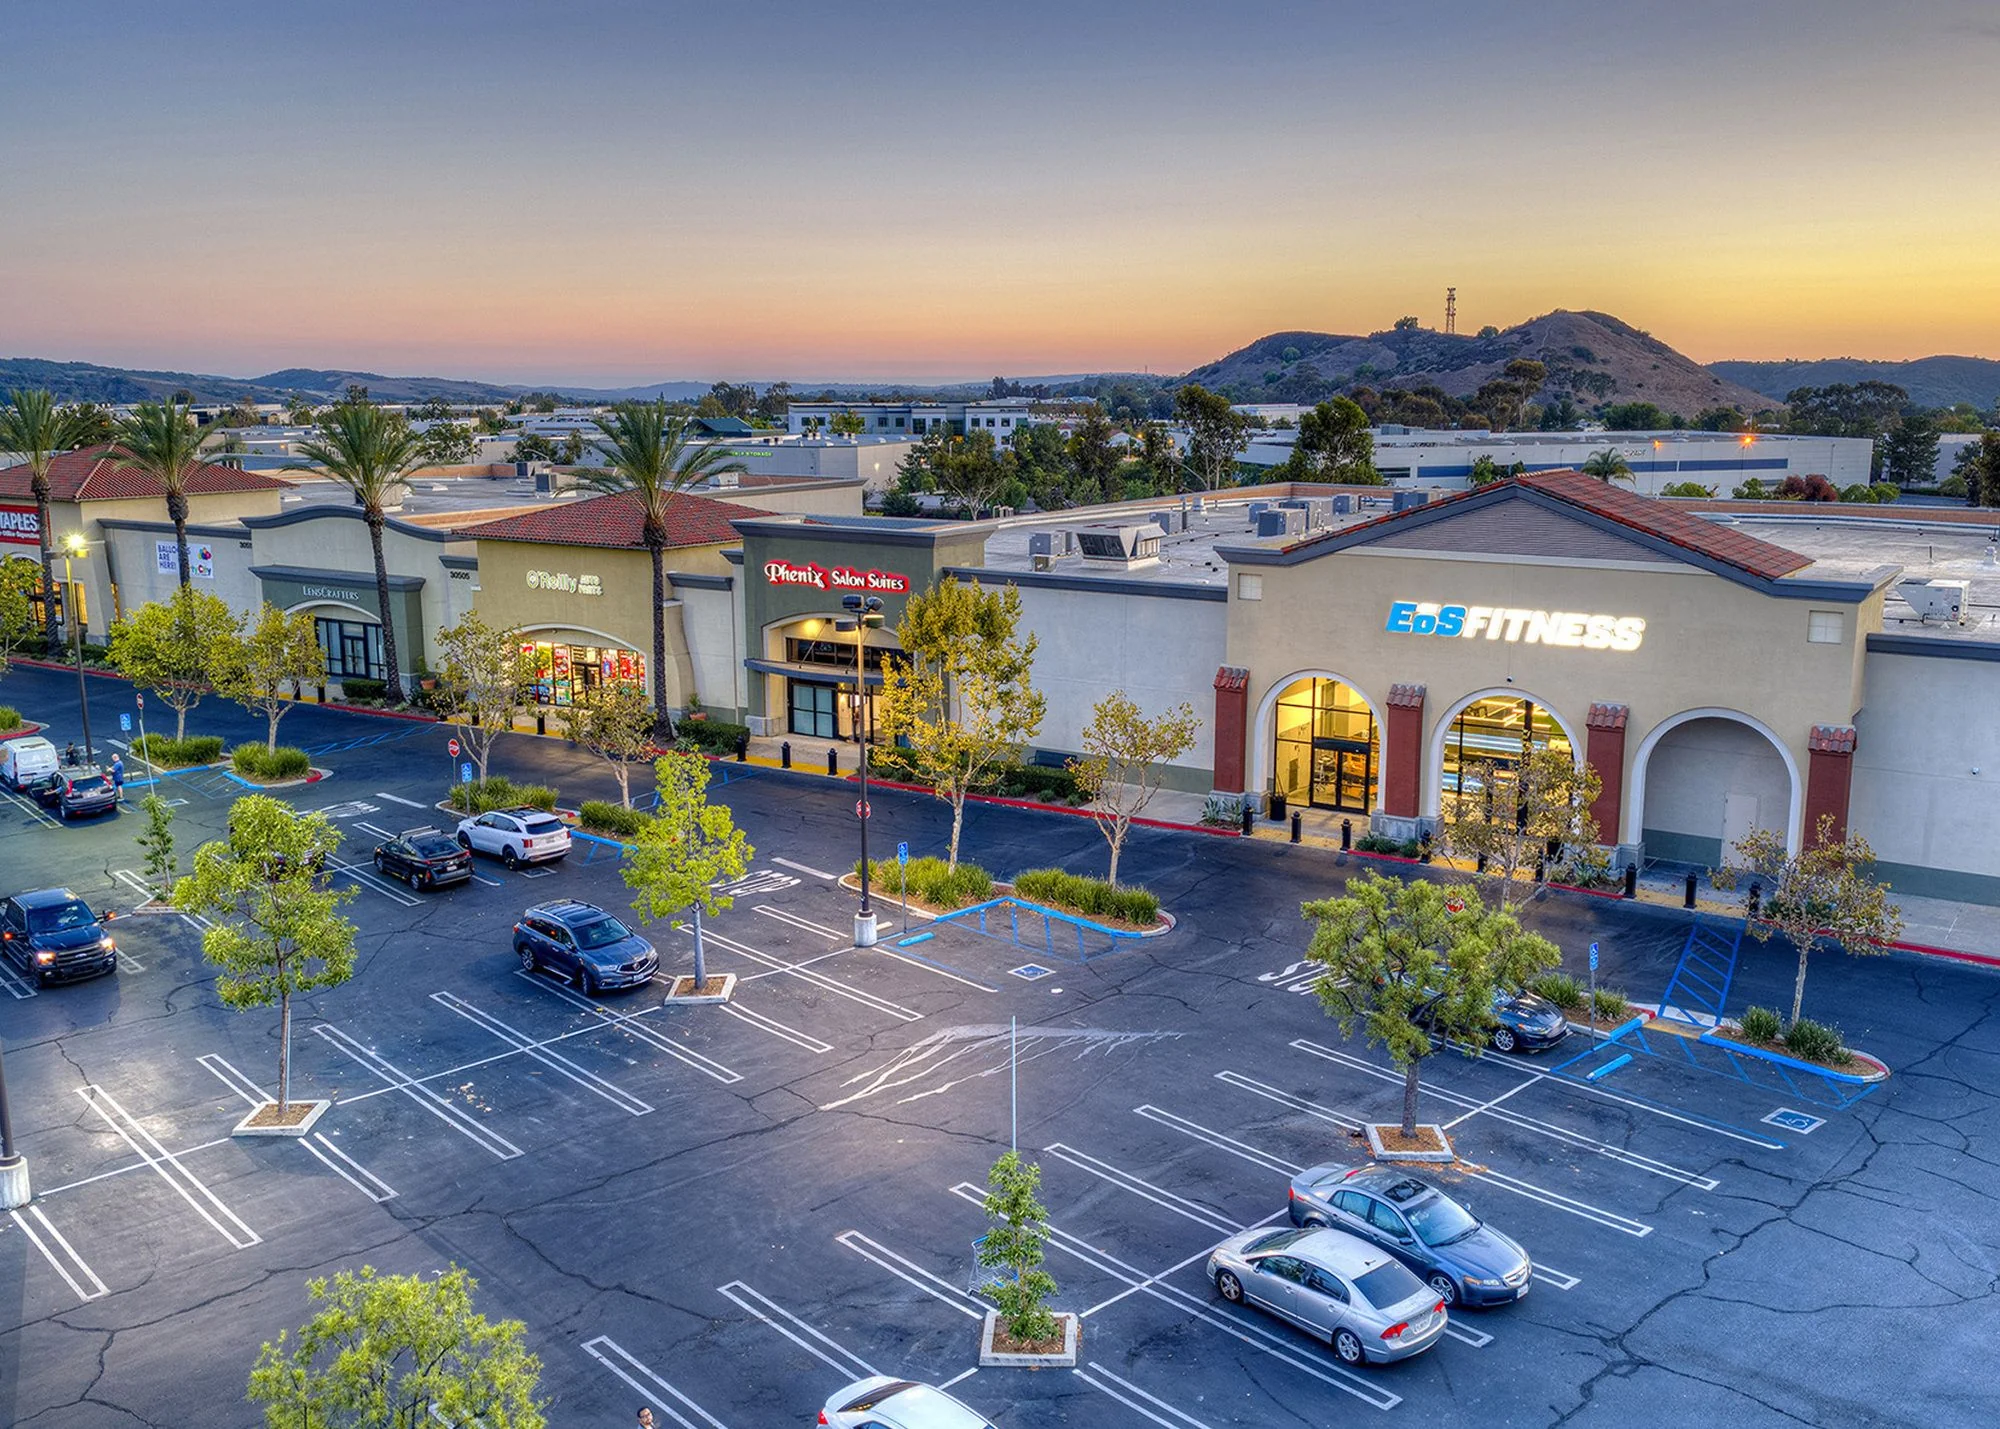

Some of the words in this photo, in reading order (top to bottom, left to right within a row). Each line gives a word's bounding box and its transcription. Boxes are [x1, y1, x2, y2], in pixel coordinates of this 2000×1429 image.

[0, 511, 38, 532] TAPLES
[159, 553, 170, 561] ARE
[159, 561, 176, 570] HERE!
[449, 570, 471, 580] 30505
[526, 569, 578, 594] O'Reilly
[764, 563, 826, 588] Phenix
[1462, 605, 1647, 651] FITNESS
